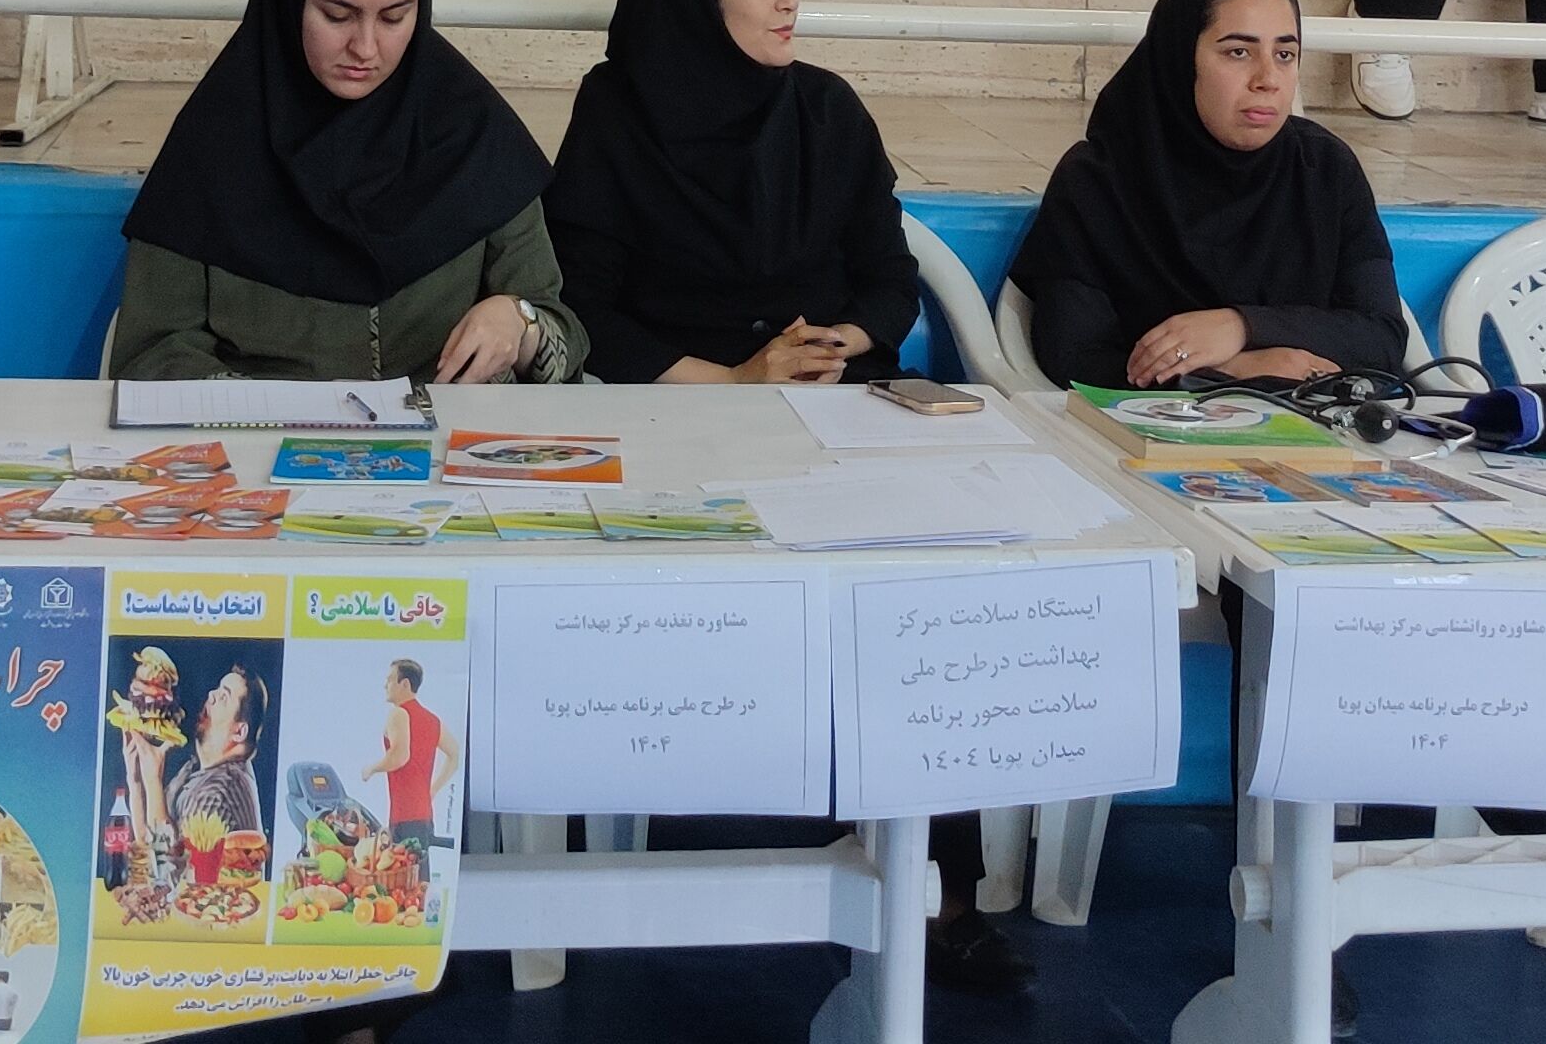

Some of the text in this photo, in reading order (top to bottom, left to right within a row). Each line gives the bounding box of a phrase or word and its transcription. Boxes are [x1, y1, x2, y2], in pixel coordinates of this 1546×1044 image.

[125, 591, 262, 621] انتخاب با شماست!
[383, 594, 396, 622] یا
[399, 593, 446, 625] چاقی
[896, 594, 1101, 637] ایستگاه سلامت مرکز
[555, 612, 748, 634] مشاوره تغذیه مرکز بهداشت
[1334, 617, 1546, 638] مشاوره روانشناسی مرکز بهداشت
[1018, 644, 1100, 670] بهداشت
[901, 657, 936, 686] ملی
[6, 646, 68, 732] چرا
[545, 696, 757, 717] در طرح ملی برنامه میدان پویا
[907, 692, 1098, 729] سلامت محور برنامه
[1338, 696, 1362, 715] پویا
[1364, 696, 1405, 715] میدان
[1409, 697, 1448, 716] برنامه
[1450, 697, 1478, 716] ملی
[989, 747, 1022, 770] پویا
[1031, 741, 1086, 767] میدان
[103, 966, 122, 986] بالا
[122, 966, 151, 988] خون
[153, 970, 188, 989] چربی
[354, 967, 384, 984] خطر
